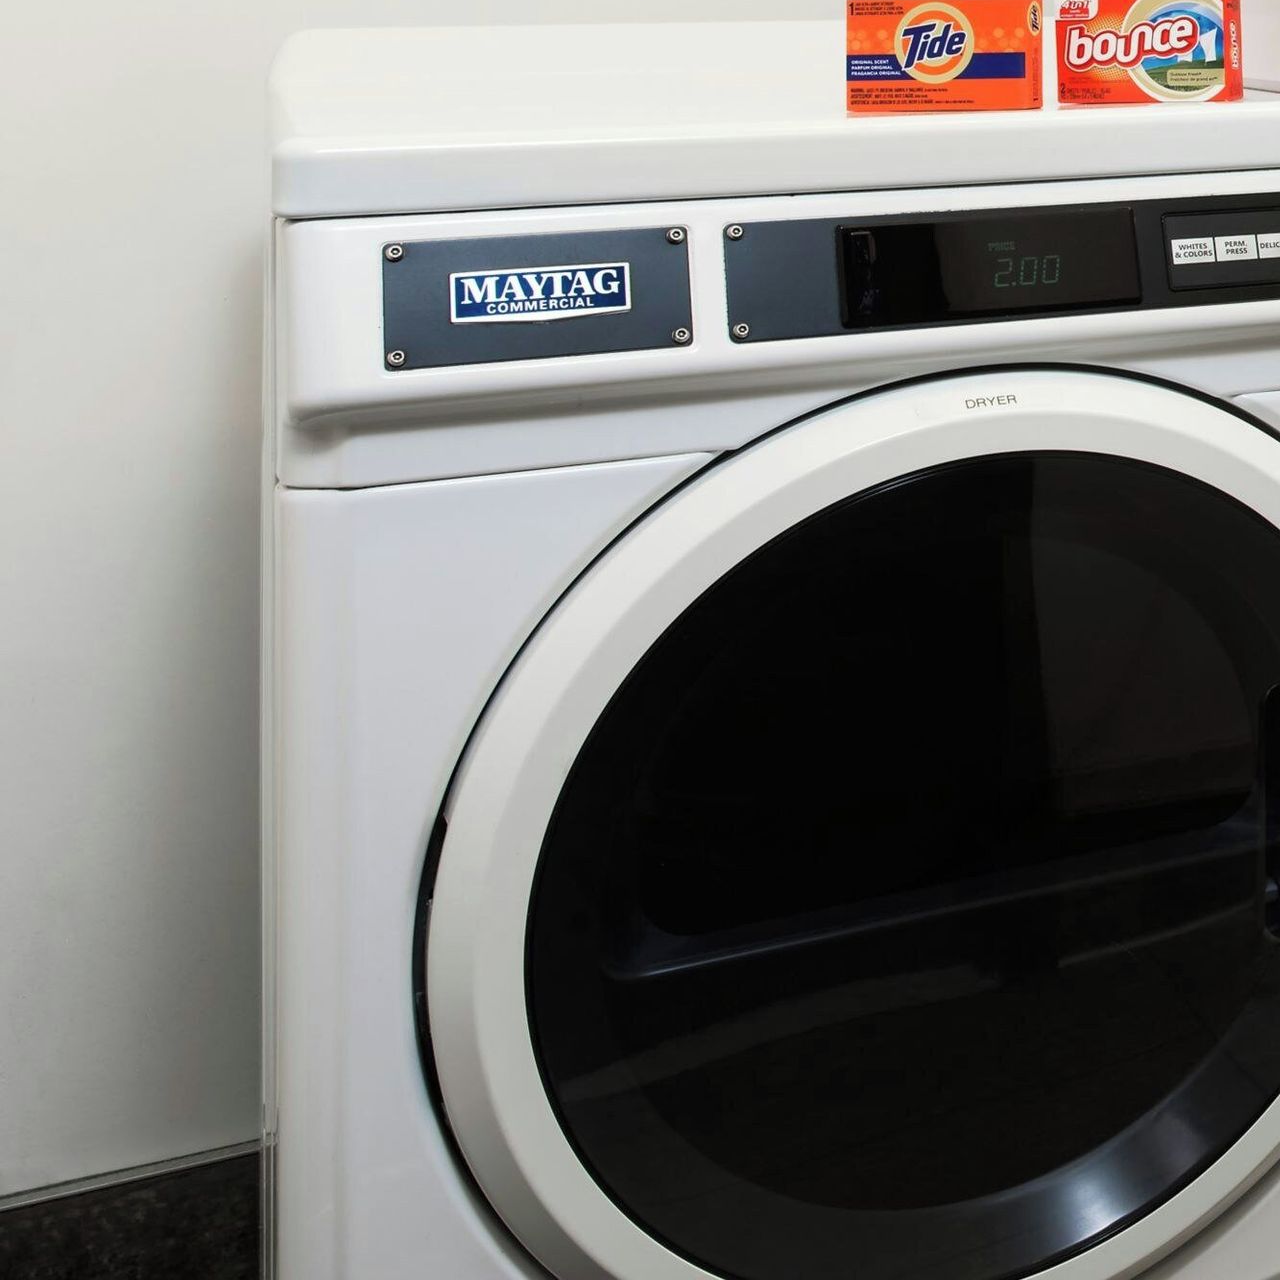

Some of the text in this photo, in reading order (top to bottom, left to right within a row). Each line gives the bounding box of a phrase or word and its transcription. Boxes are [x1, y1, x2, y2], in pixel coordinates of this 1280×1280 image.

[849, 2, 854, 16] 1
[1030, 4, 1041, 32] Tide
[902, 22, 967, 69] Tide
[1067, 17, 1194, 67] bounce
[988, 241, 1016, 252] PRICE
[1178, 242, 1208, 251] WHITES
[1224, 240, 1248, 248] PERM.
[1183, 250, 1213, 258] COLORS
[994, 255, 1061, 288] 2.00
[460, 269, 621, 305] MAYTAG
[486, 296, 595, 315] COMMERCIAL
[964, 394, 1018, 409] DRYER
